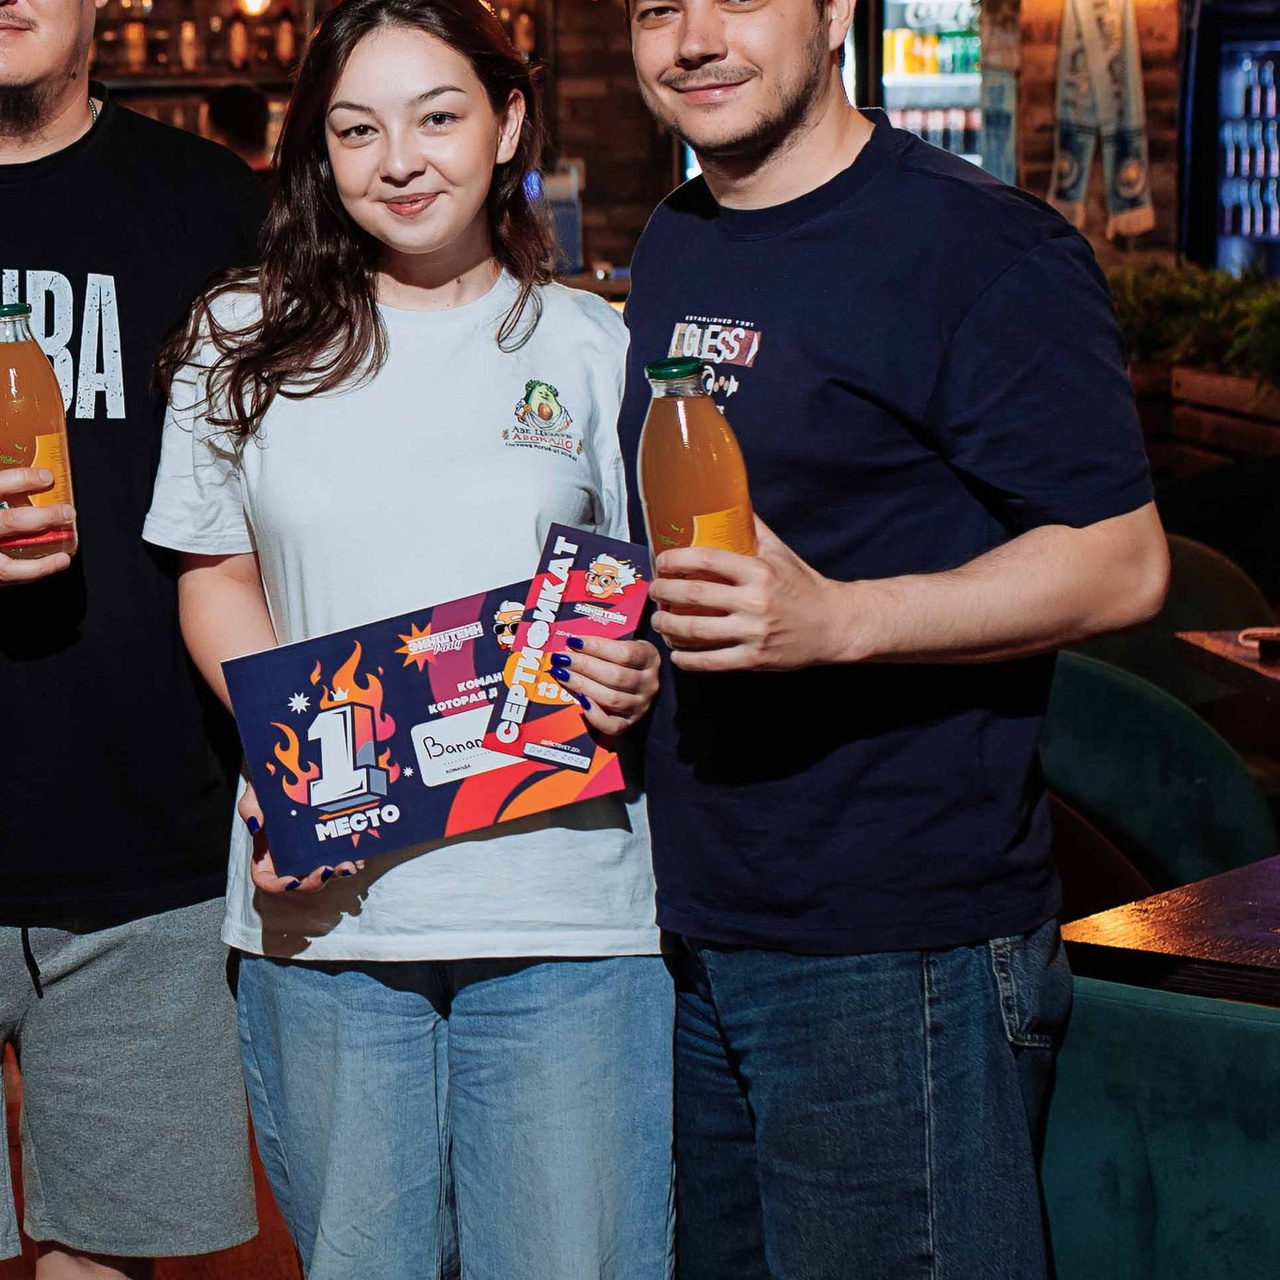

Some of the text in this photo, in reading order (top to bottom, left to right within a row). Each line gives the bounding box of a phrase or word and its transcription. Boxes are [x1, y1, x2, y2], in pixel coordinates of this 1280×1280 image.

[685, 315, 732, 325] ESTABLISHED
[496, 535, 579, 744] СЕРТИФИКАТ
[457, 672, 505, 692] КОМАН
[428, 690, 488, 714] КОТОРАЯ
[314, 804, 401, 842] МЕСТО
